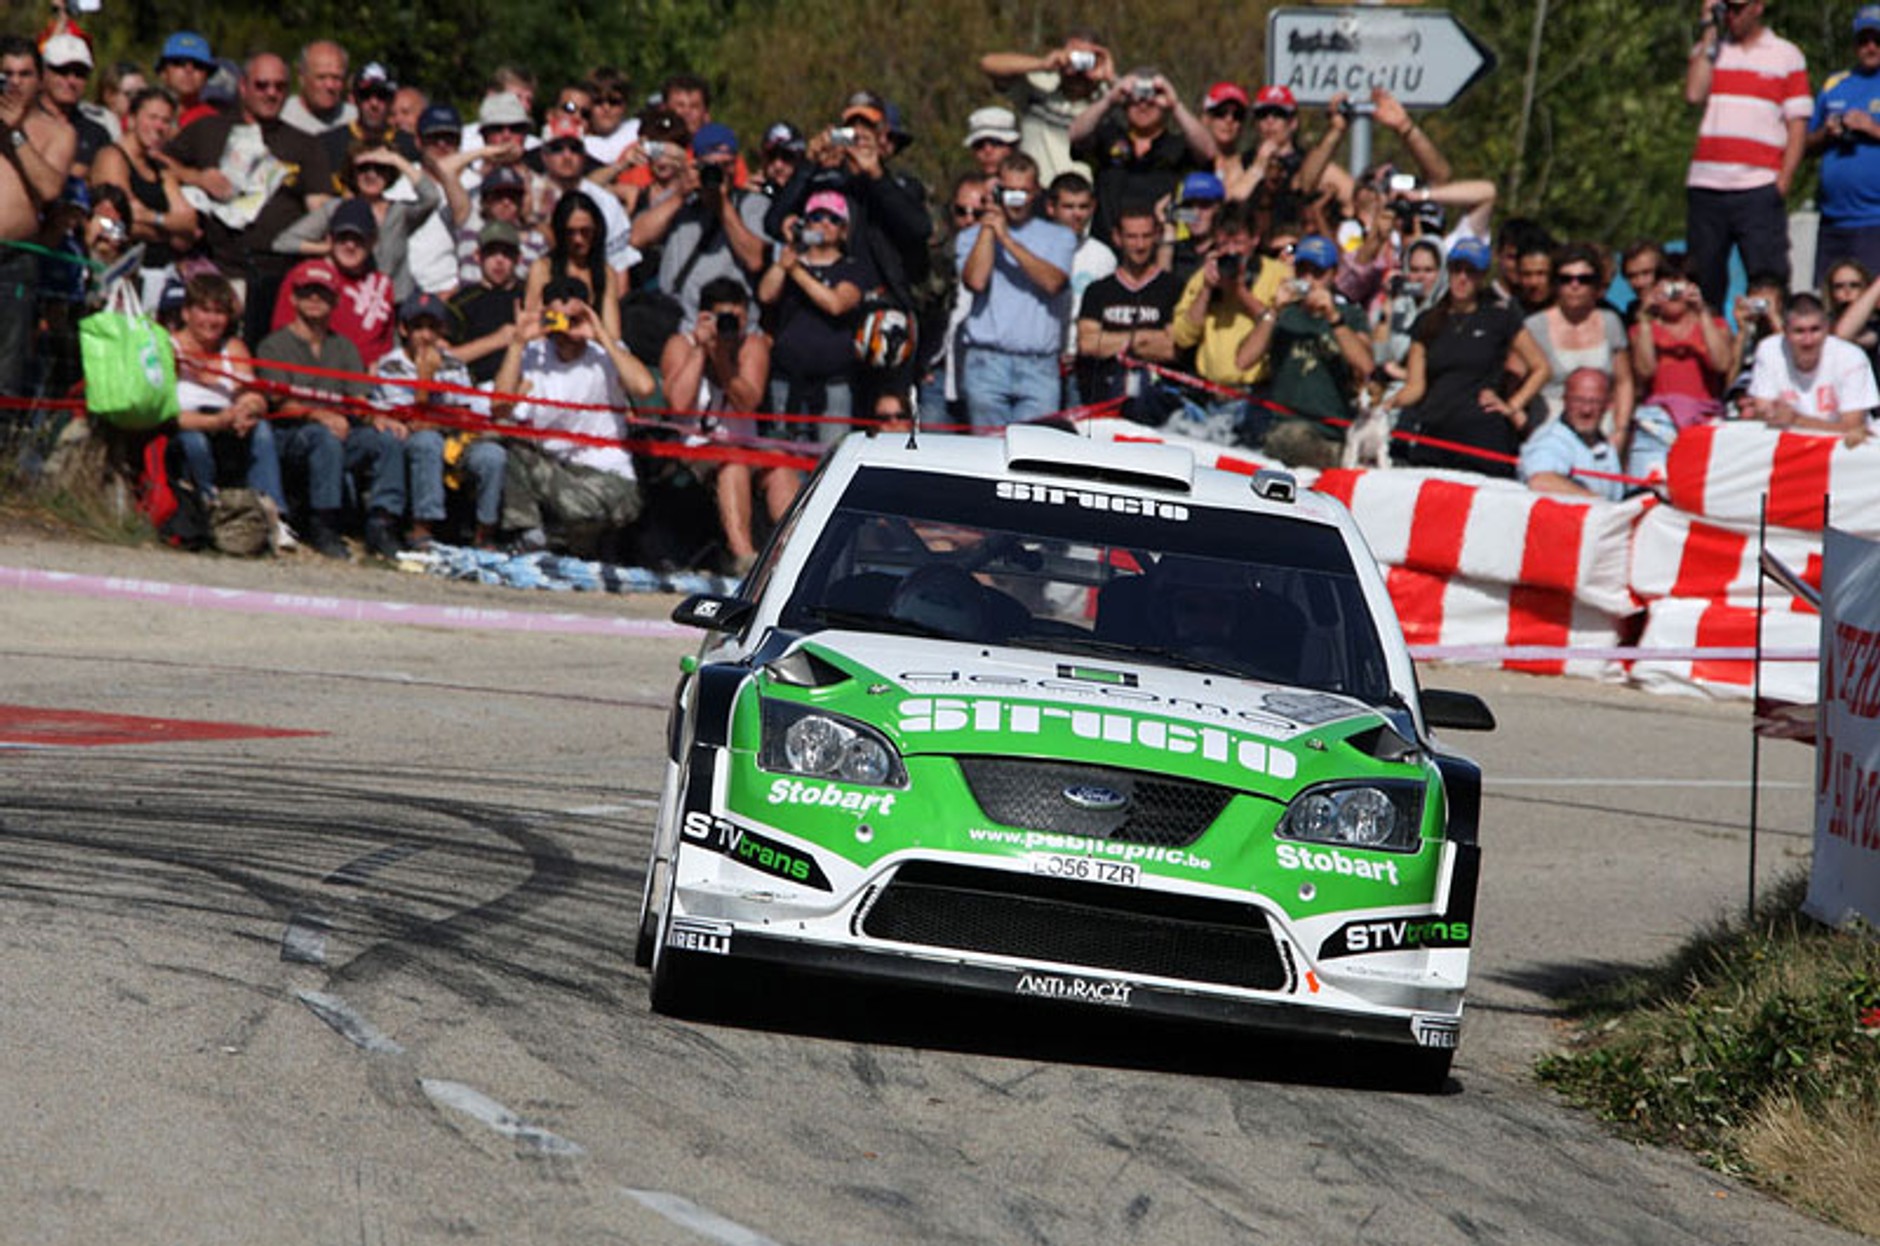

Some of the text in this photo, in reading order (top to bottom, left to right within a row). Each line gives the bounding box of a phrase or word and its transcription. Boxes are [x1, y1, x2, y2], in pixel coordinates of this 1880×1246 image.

[767, 778, 895, 815] Stobart
[683, 811, 811, 880] STVtrans
[1275, 843, 1399, 886] Stobart
[1096, 862, 1135, 884] TZR
